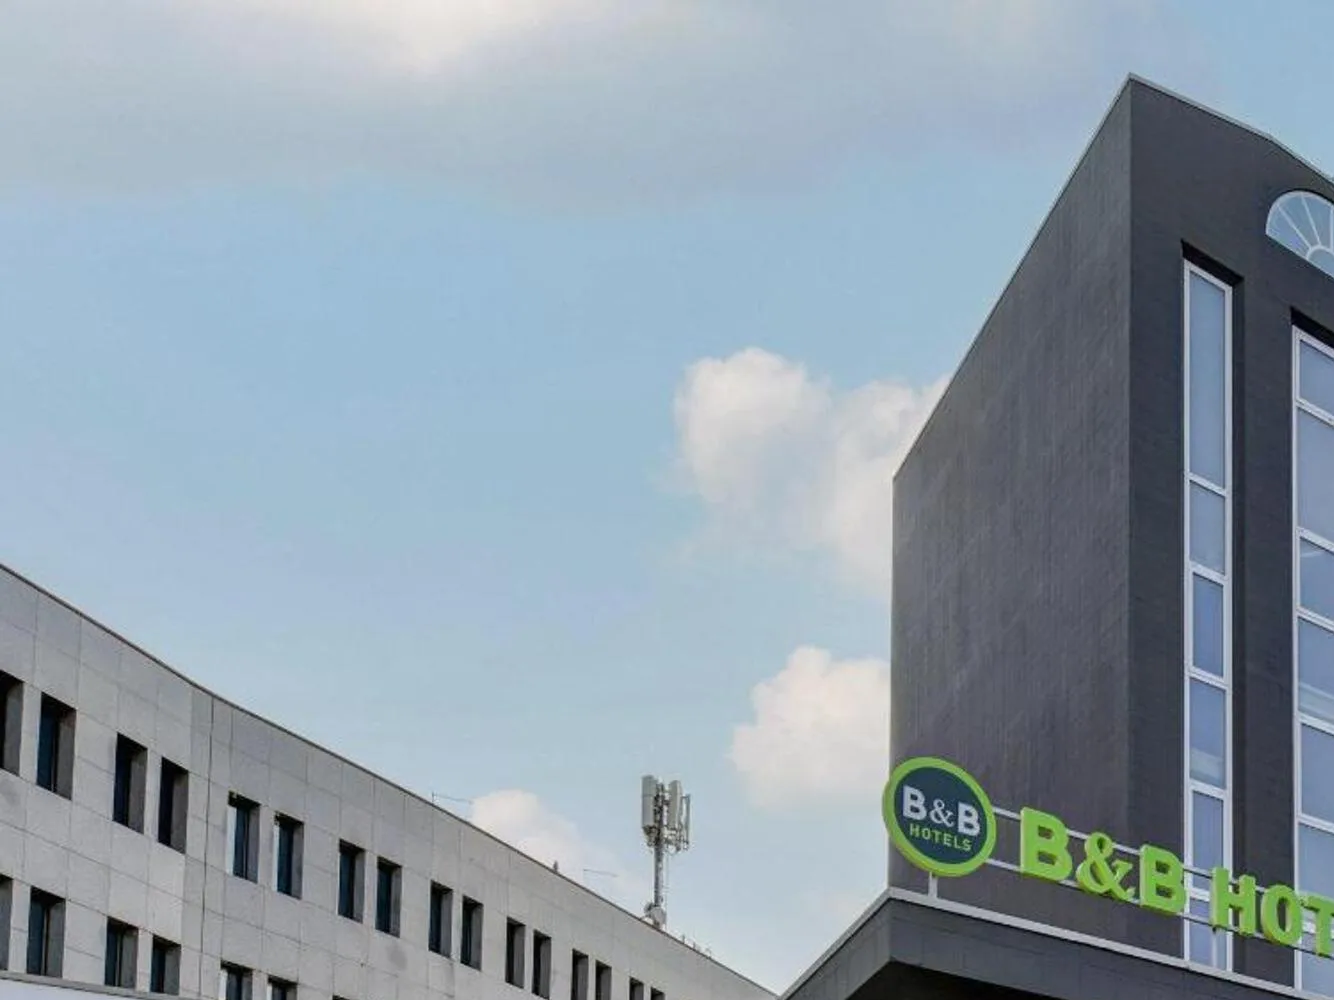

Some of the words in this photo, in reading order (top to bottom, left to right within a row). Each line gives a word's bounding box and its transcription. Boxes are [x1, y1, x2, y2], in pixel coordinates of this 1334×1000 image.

[903, 785, 980, 836] B&B
[909, 823, 972, 852] HOTELS
[1020, 806, 1187, 914] B&B
